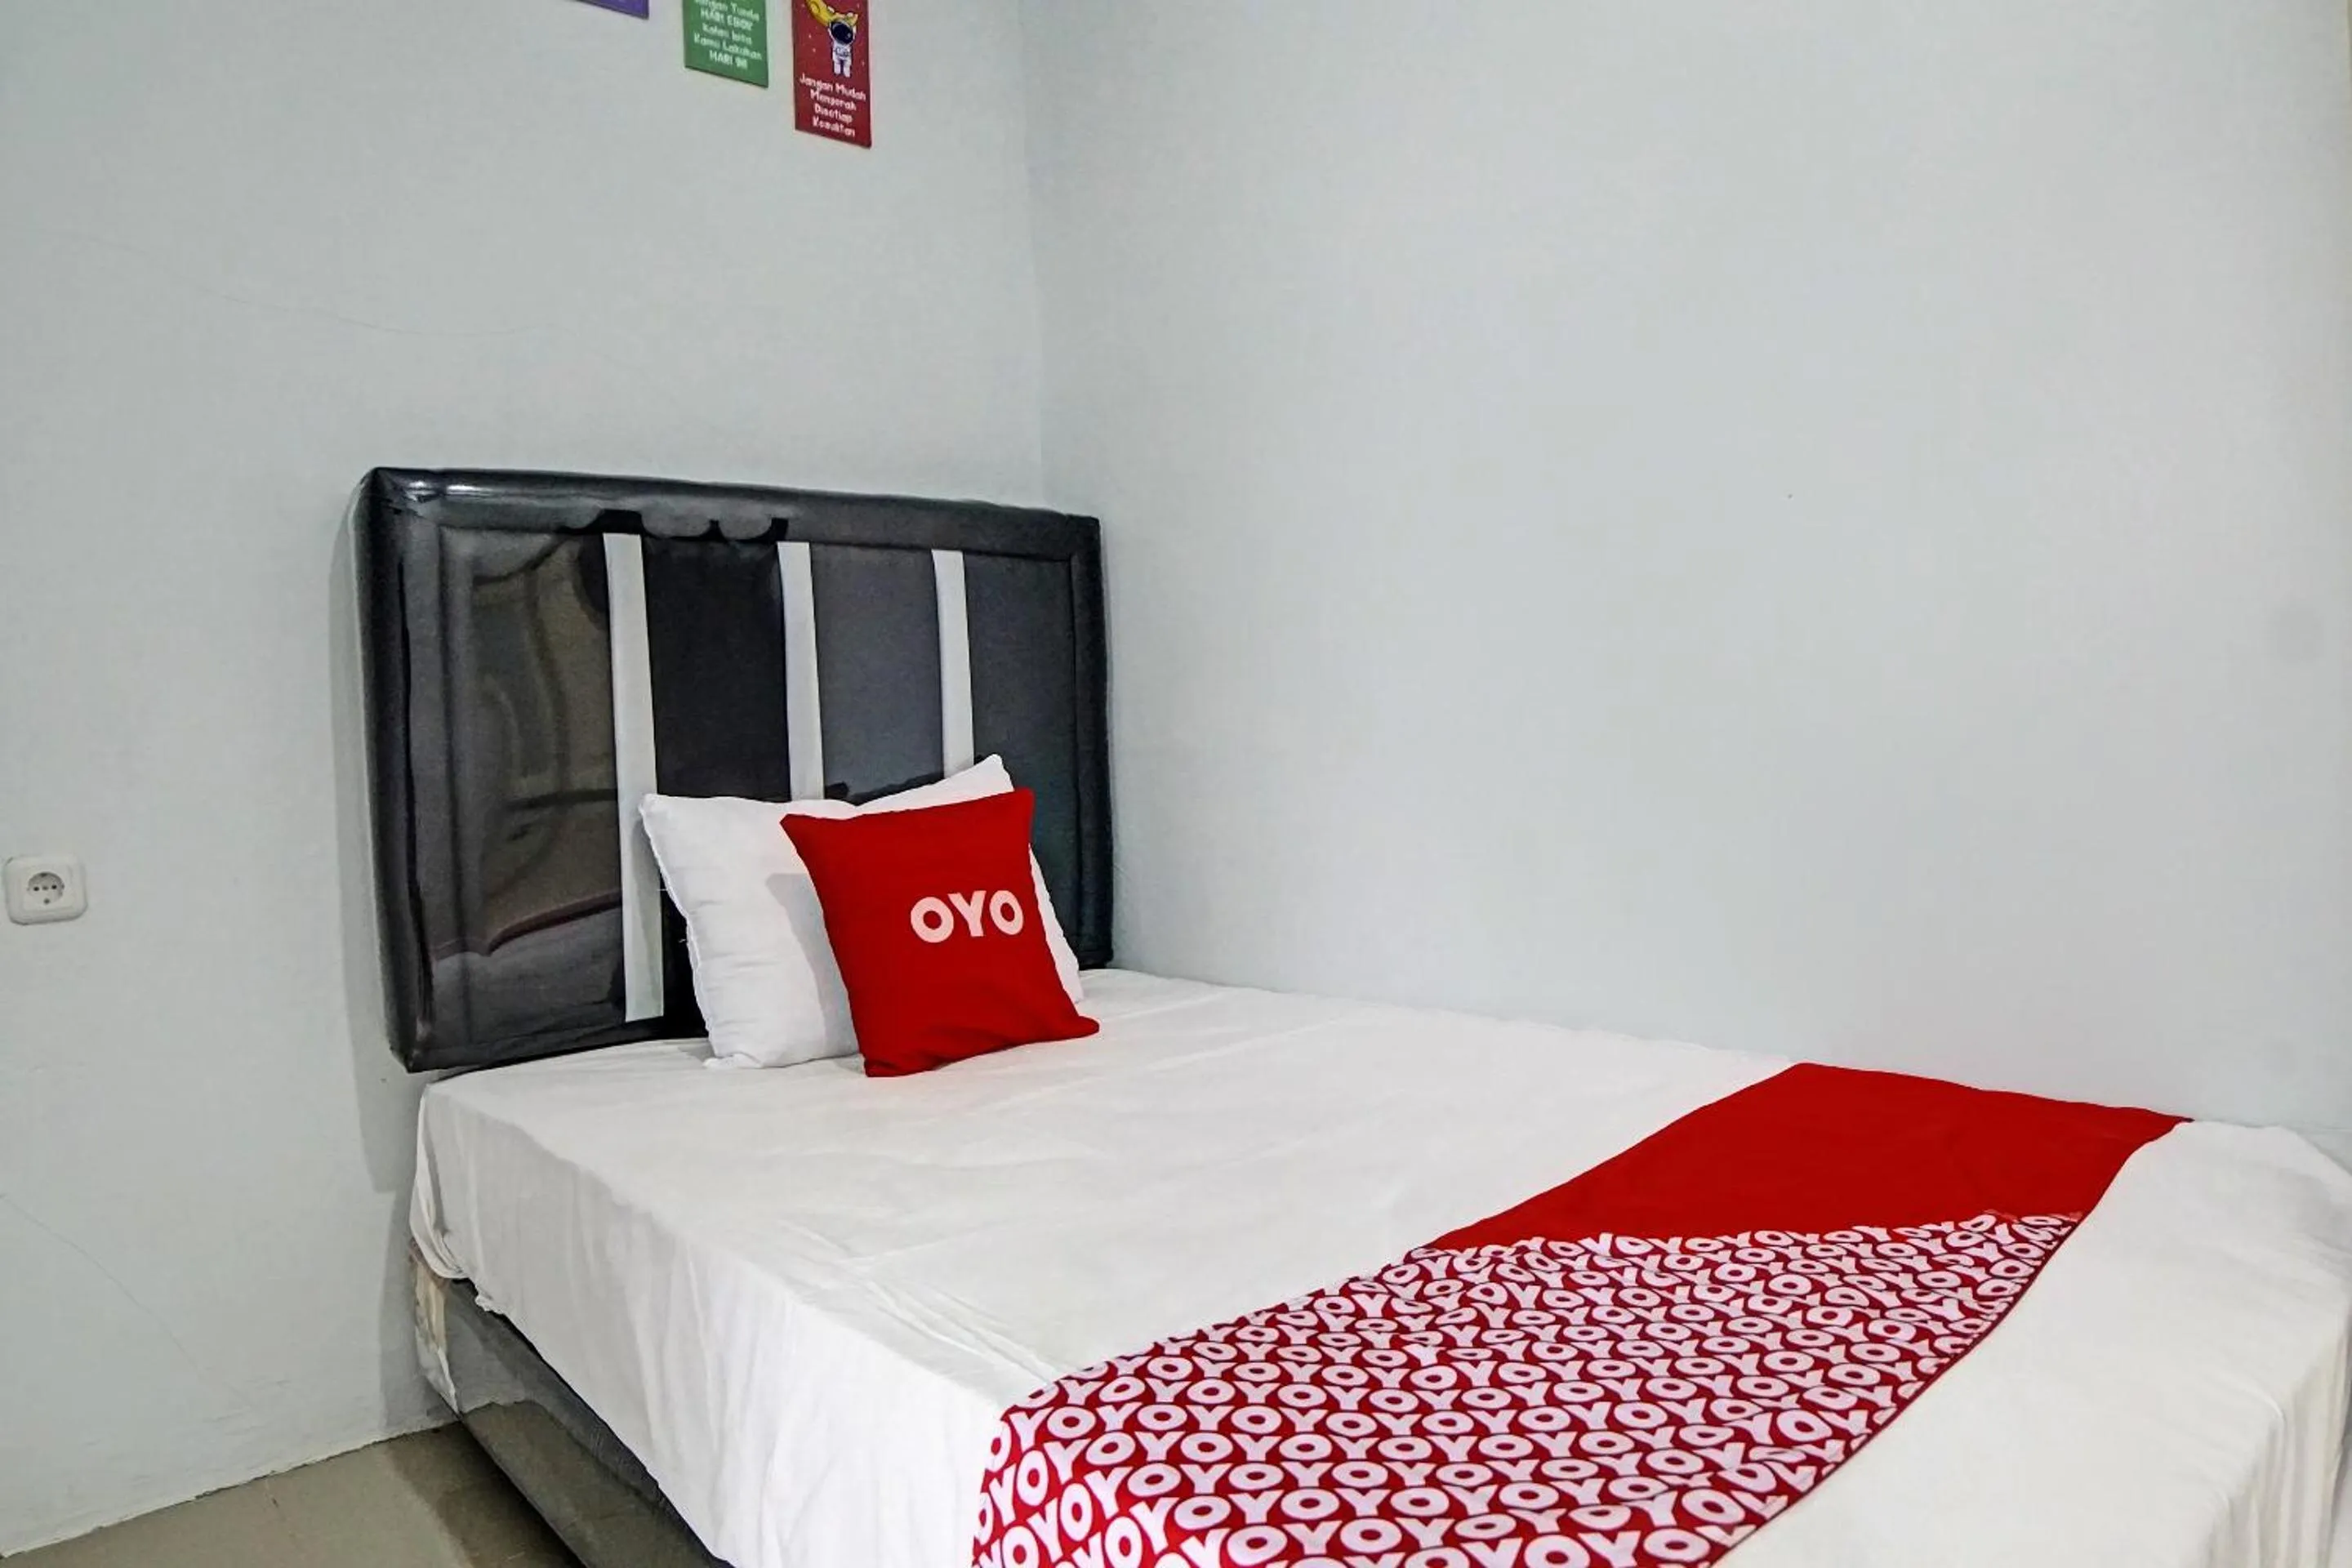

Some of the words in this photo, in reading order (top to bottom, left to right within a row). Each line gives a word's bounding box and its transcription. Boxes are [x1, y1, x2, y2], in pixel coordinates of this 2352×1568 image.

[700, 7, 724, 24] HARI
[710, 50, 733, 66] HARI
[800, 73, 833, 92] Jangan
[835, 83, 866, 102] Mudah
[911, 890, 1023, 943] OYO
